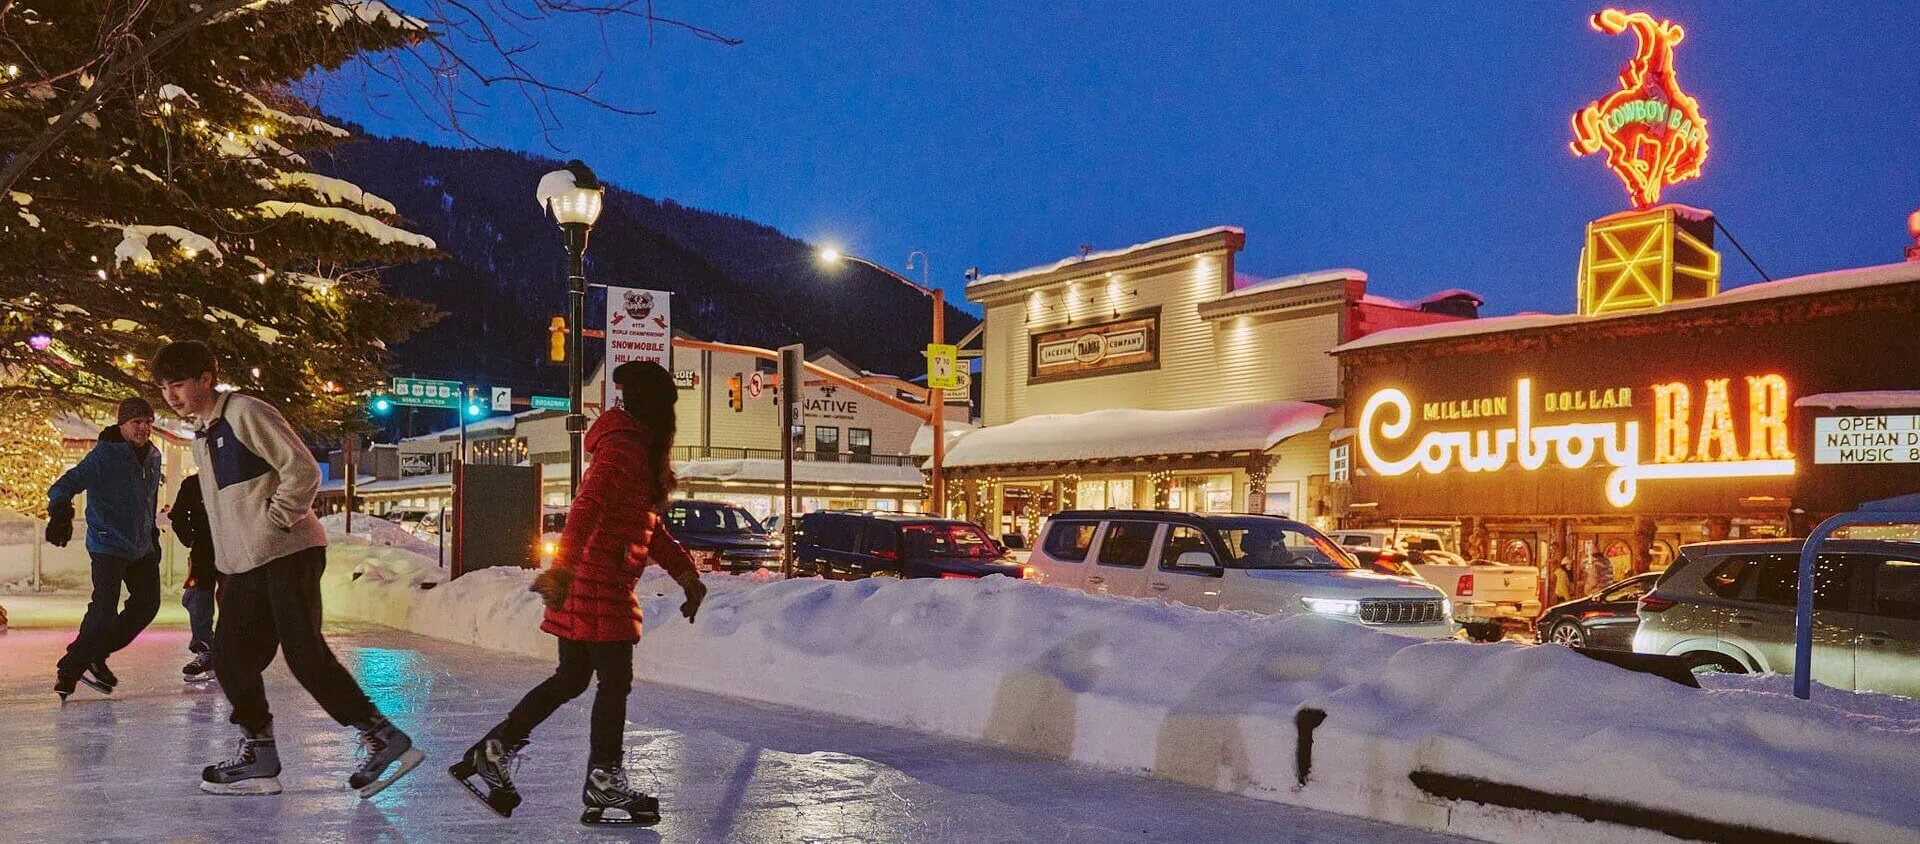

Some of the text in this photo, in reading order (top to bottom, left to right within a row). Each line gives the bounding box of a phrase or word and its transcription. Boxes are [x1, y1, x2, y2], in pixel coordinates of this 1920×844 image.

[1605, 100, 1702, 147] COWBOY BAR
[611, 341, 664, 351] SNOWMOBILE
[1045, 347, 1072, 359] JACKSON
[1109, 336, 1141, 348] COMPANY
[535, 399, 565, 407] BROADWAY
[804, 398, 858, 414] NATIVE
[1423, 387, 1632, 421] MILLION DOLLAR
[1838, 416, 1888, 431] OPEN
[1359, 373, 1797, 508] Cowboy BAR
[1827, 432, 1899, 447] NATHAN
[1840, 448, 1894, 462] MUSIC
